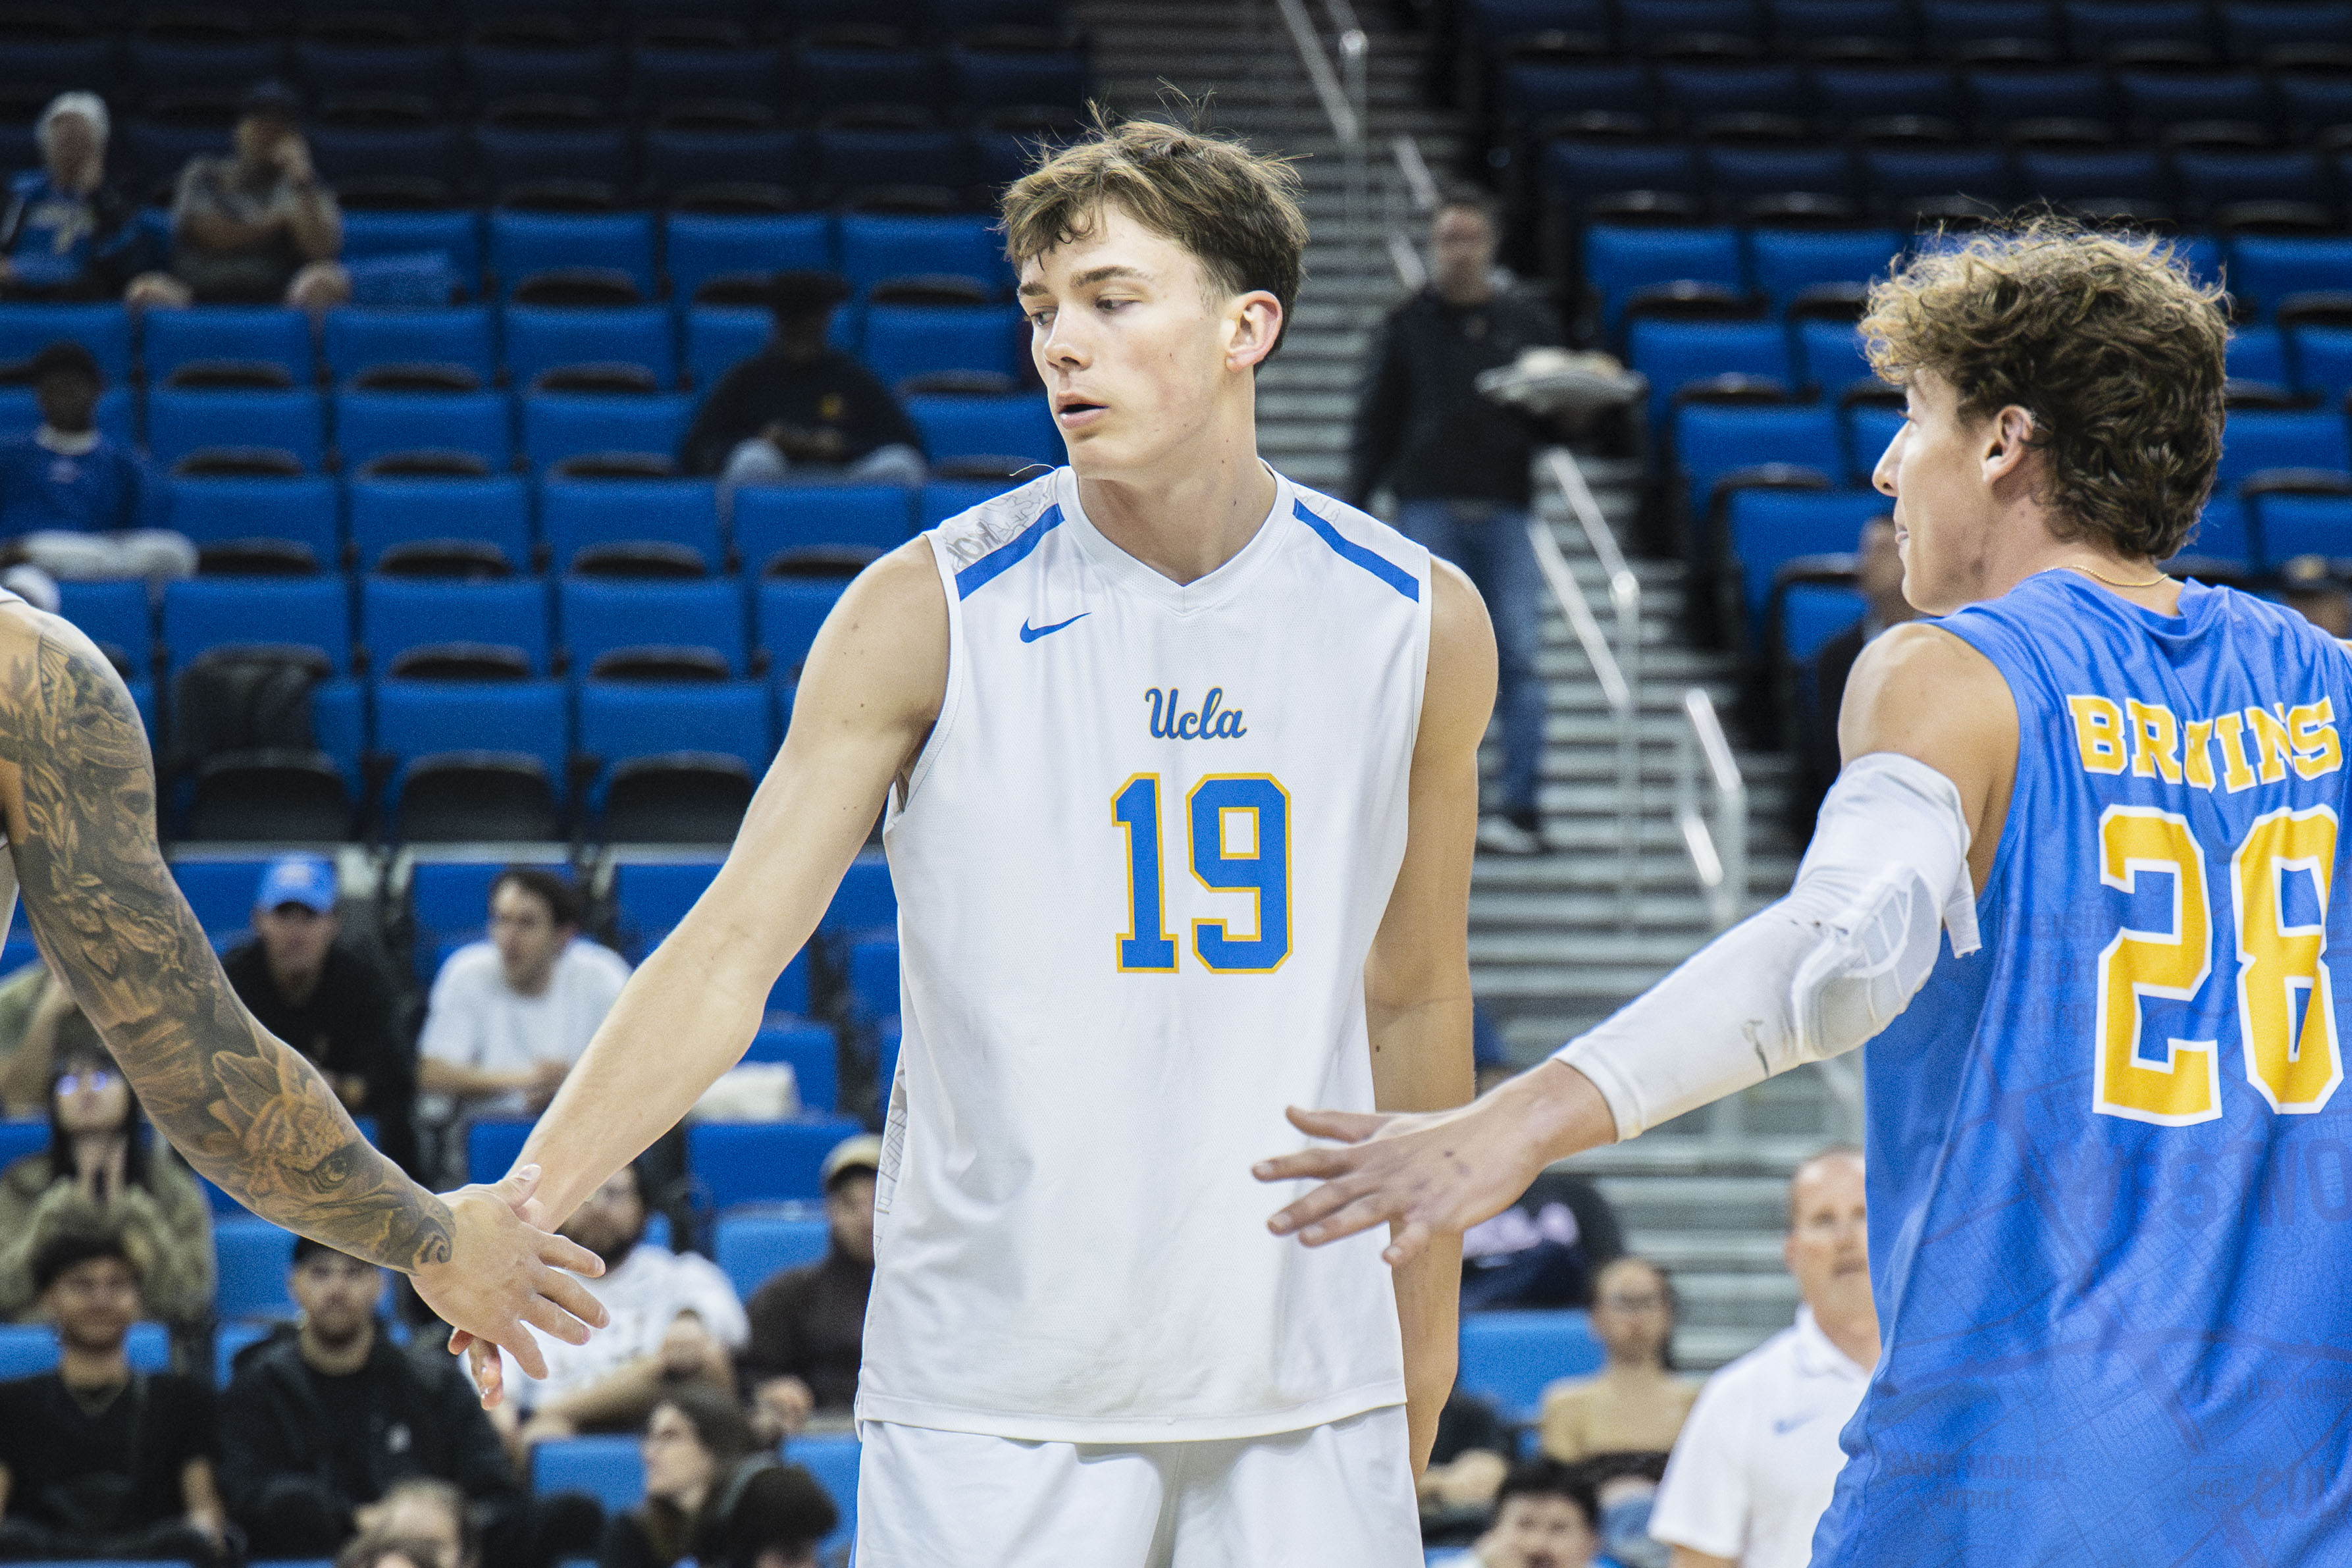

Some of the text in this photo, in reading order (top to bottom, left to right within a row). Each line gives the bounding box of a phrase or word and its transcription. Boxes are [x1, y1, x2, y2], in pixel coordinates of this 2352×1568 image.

[2066, 694, 2343, 795] BRUINS
[1110, 772, 1294, 975] 19
[2093, 804, 2345, 1128] 28
